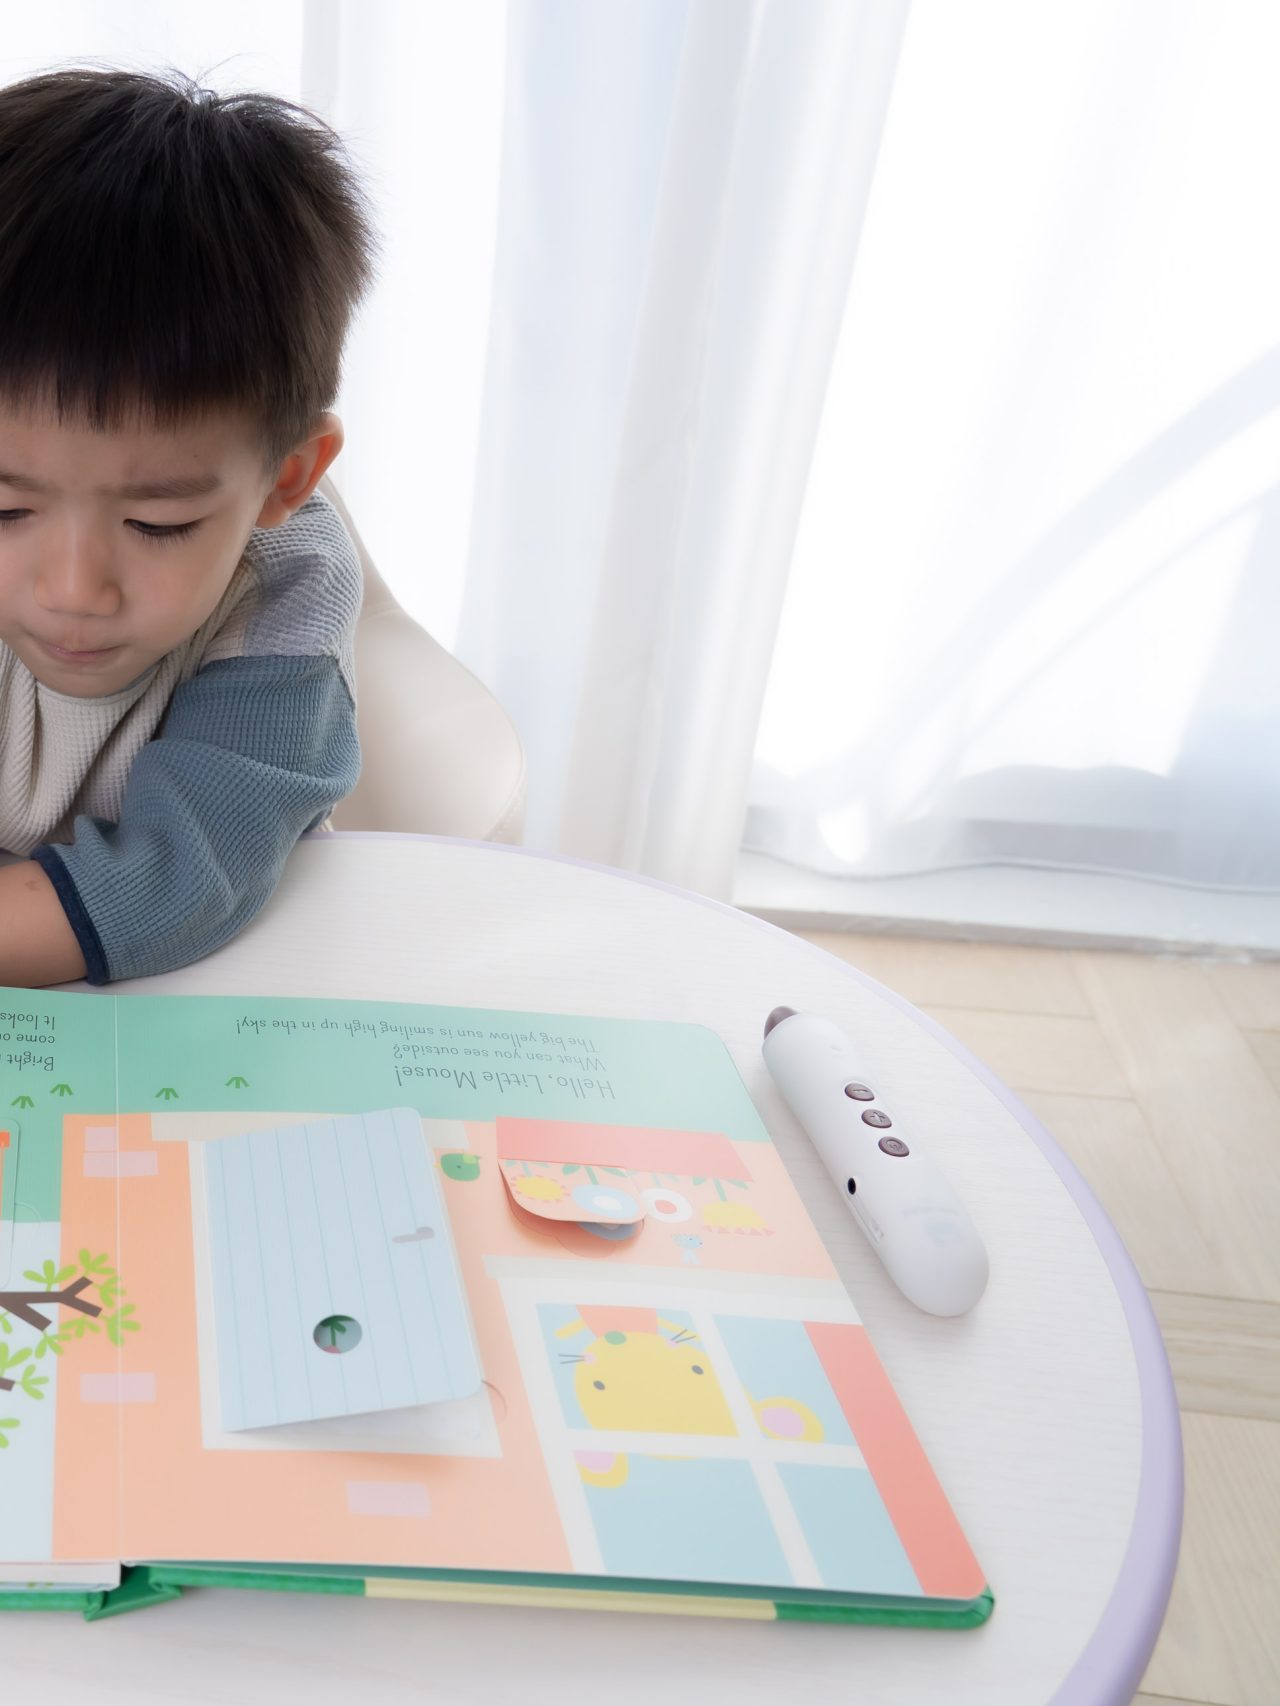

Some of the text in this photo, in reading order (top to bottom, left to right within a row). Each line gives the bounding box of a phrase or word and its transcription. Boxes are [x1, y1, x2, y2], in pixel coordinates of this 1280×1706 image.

[0, 1012, 39, 1031] looks
[43, 1015, 56, 1031] It
[16, 1033, 56, 1044] come
[236, 1015, 601, 1054] The big yellow sun is smiling high up in the sky!
[6, 1050, 55, 1072] Bright
[392, 1043, 607, 1072] What can you see outside?
[394, 1065, 616, 1100] Hello, Little Mouse!
